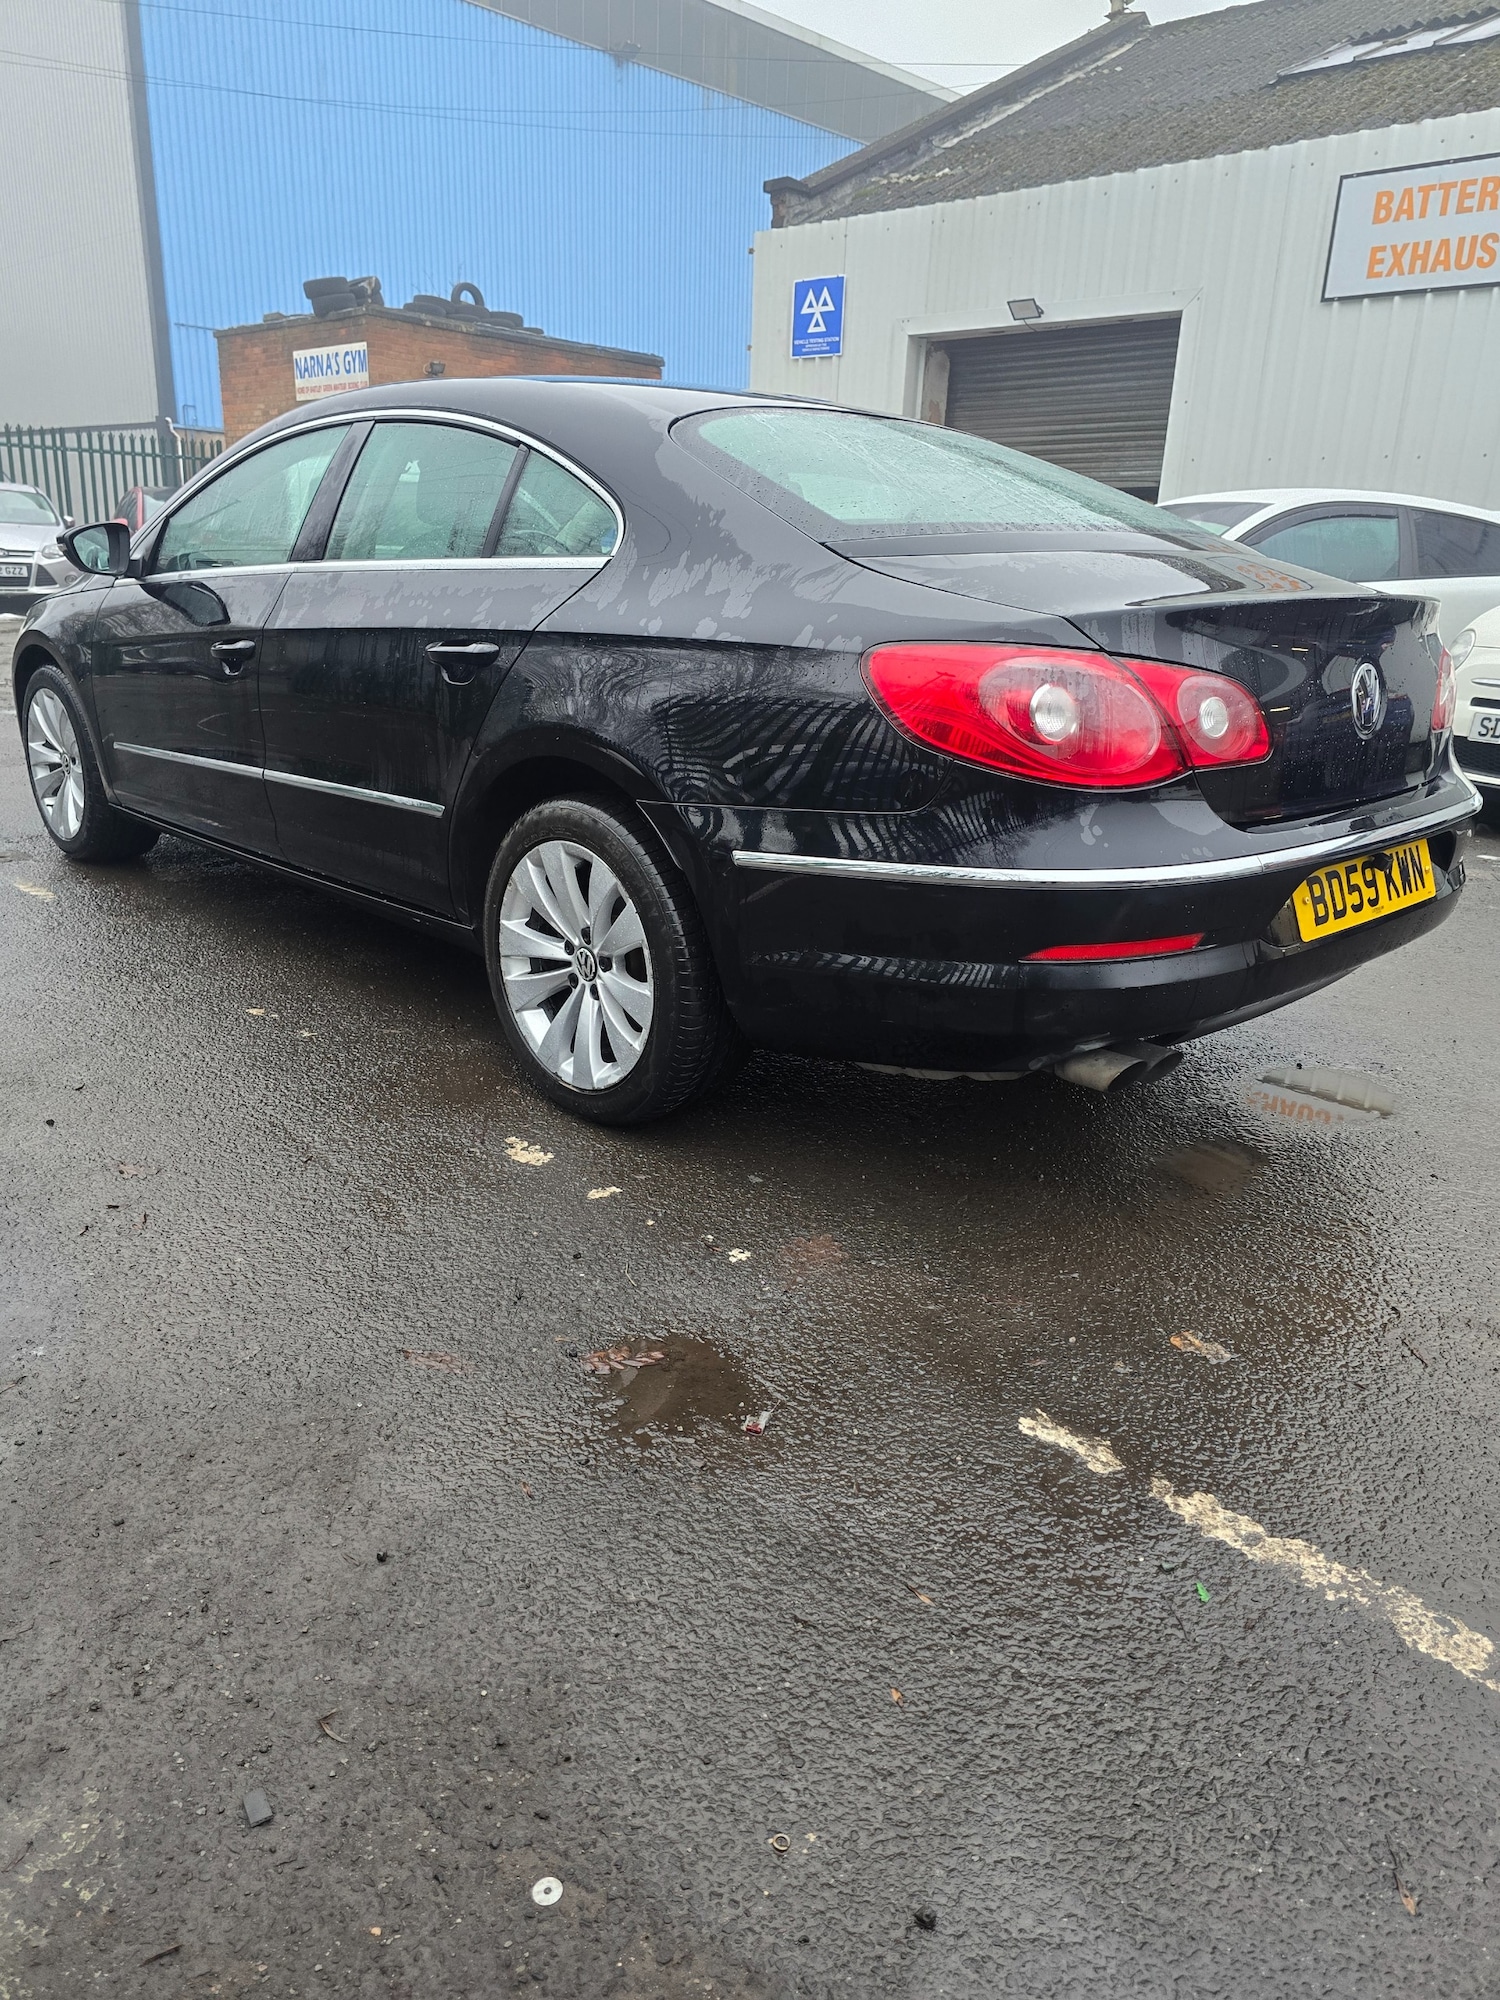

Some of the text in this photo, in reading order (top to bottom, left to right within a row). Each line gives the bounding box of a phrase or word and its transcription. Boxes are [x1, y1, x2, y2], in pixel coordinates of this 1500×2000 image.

[1371, 175, 1500, 225] BATTER
[1366, 232, 1500, 279] EXHAUS
[295, 349, 368, 380] NARNA'S GYM
[5, 566, 24, 576] GZZ
[1306, 859, 1380, 927] BD59
